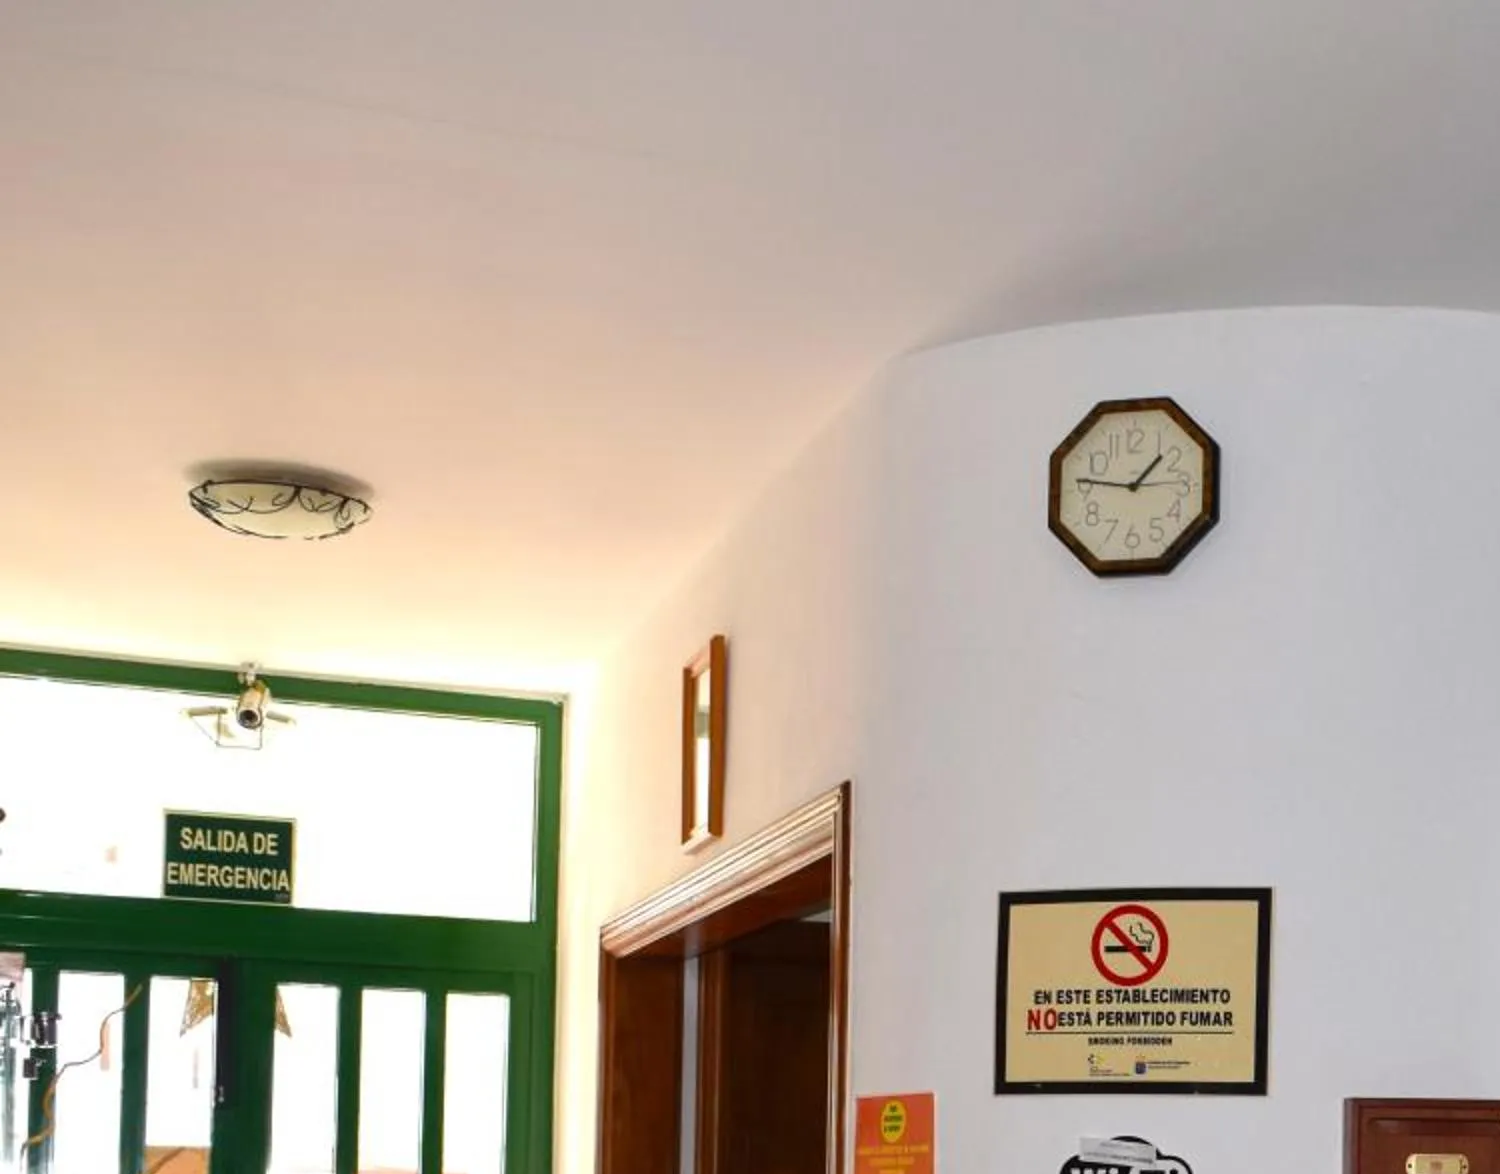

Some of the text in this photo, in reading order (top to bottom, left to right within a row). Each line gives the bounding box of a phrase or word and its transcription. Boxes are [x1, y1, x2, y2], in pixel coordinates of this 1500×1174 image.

[1109, 433, 1120, 460] 11
[1126, 428, 1145, 454] 12
[1089, 451, 1109, 476] 10
[1167, 446, 1182, 473] 2
[1176, 472, 1191, 497] 3
[1085, 501, 1099, 526] 8
[1167, 499, 1181, 522] 4
[1104, 519, 1119, 544] 7
[1125, 525, 1141, 549] 6
[1150, 517, 1165, 543] 5
[180, 826, 279, 856] SALIDA DE
[167, 862, 290, 891] EMERGENCIA
[1034, 988, 1231, 1005] EN ESTE ESTABLECIMIENTO
[1027, 1008, 1233, 1031] NO ESTÁ PERMITIDO FUMAR
[1087, 1036, 1173, 1046] SMOKING FORBIDDEN
